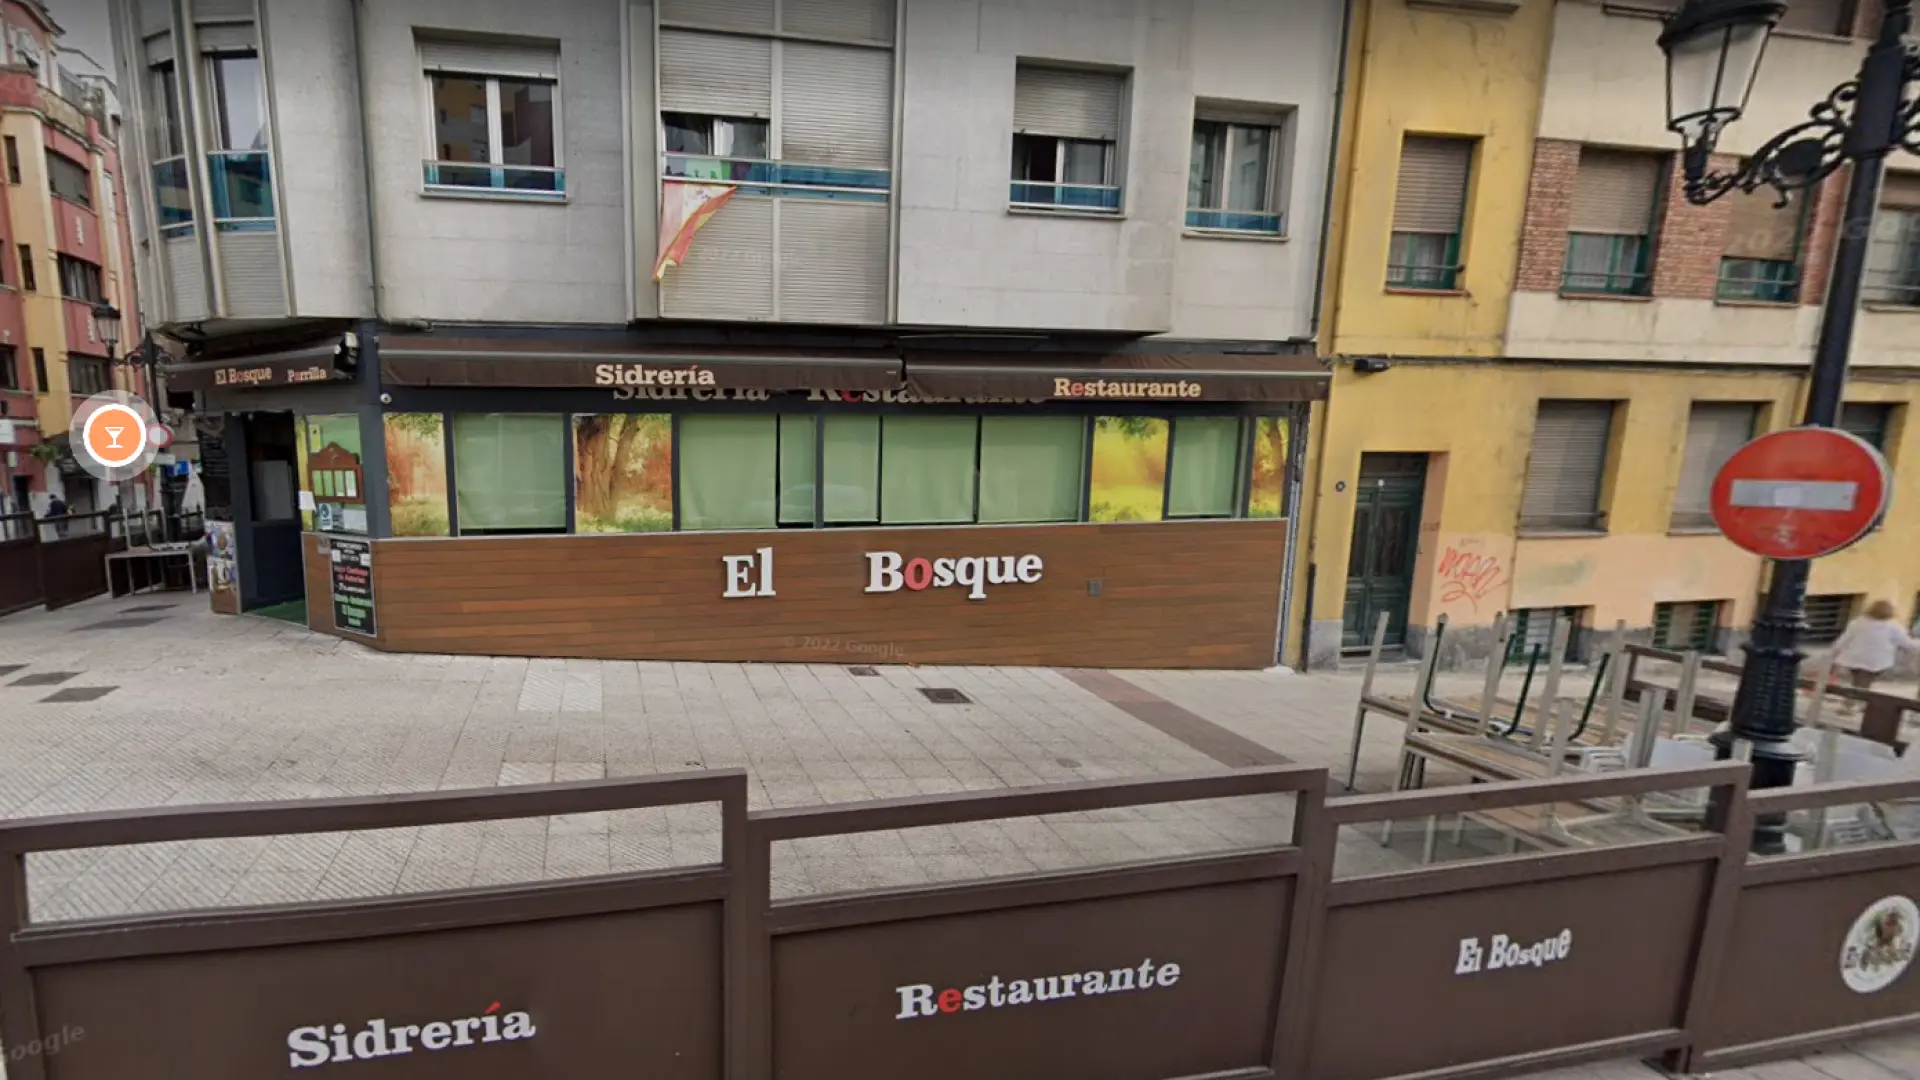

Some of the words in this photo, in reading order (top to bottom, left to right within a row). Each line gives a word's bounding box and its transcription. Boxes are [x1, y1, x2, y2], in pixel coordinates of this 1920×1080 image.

[228, 367, 272, 384] Bosque
[595, 364, 716, 386] Sidrería
[1053, 377, 1202, 398] Restaurante
[722, 547, 776, 598] El
[864, 551, 1043, 599] Bosque
[1487, 928, 1573, 968] Bosque
[895, 957, 1181, 1020] Restaurante
[286, 1001, 536, 1069] Sidrería
